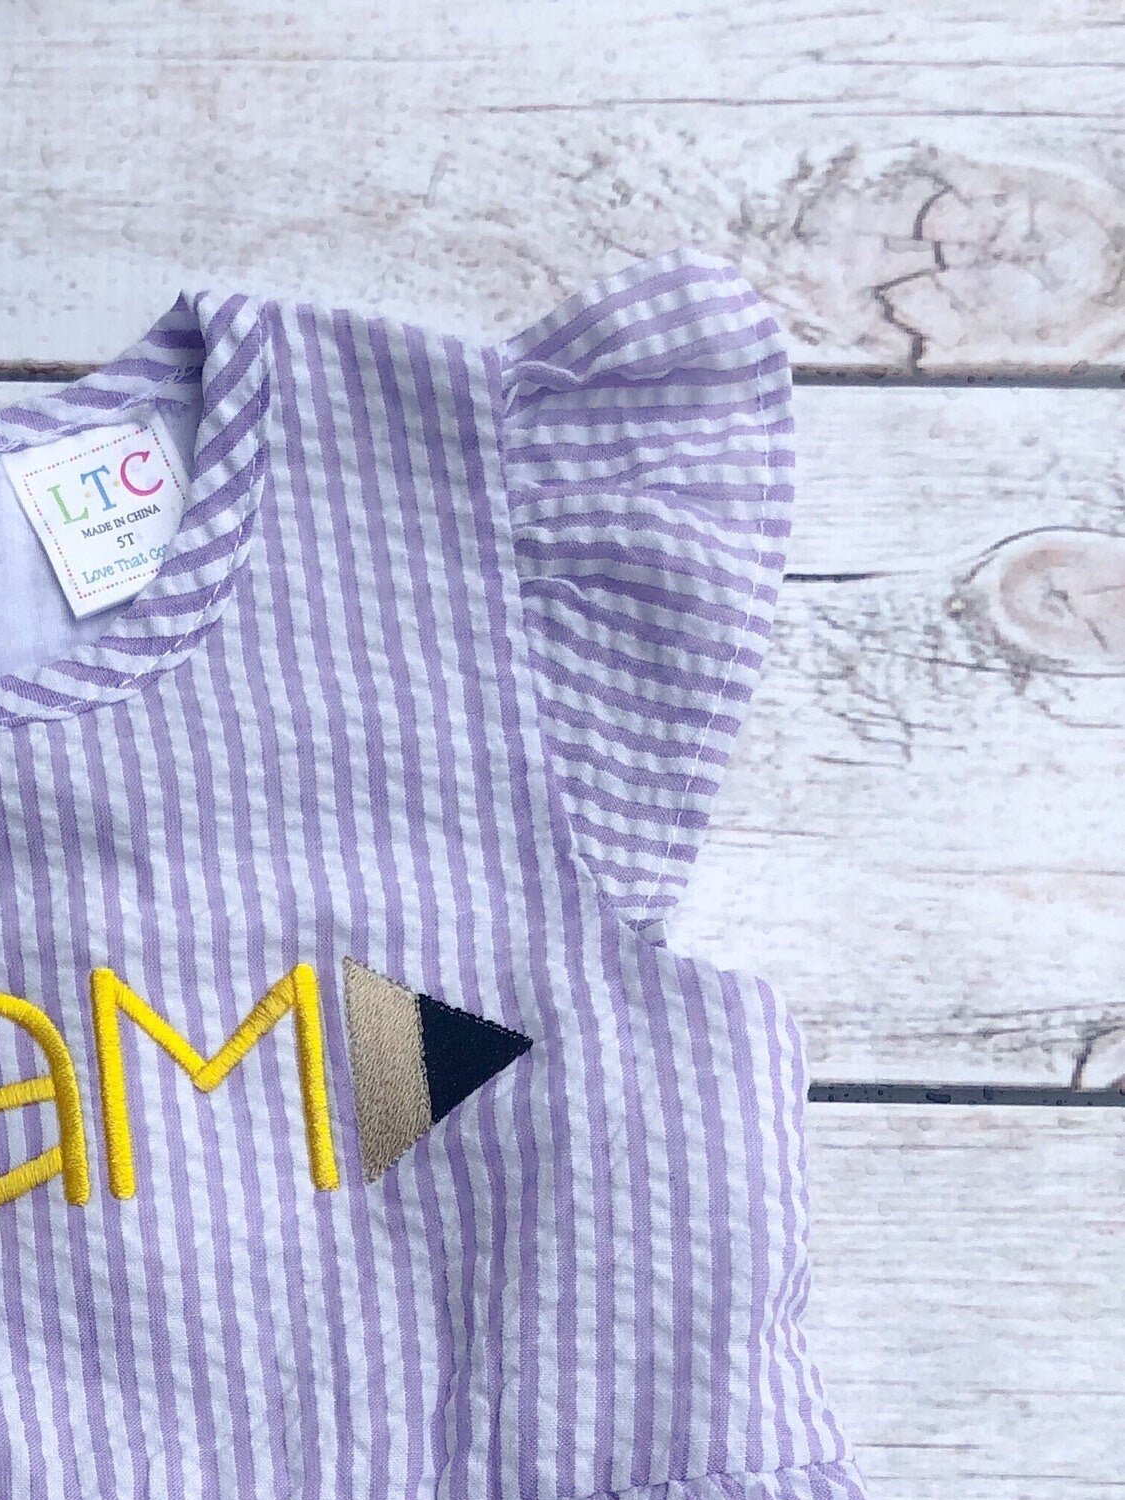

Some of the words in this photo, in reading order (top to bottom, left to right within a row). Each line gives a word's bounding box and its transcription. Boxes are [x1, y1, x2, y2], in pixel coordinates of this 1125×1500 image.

[81, 521, 113, 538] MADE
[113, 516, 126, 528] IN
[127, 504, 161, 523] CHINA
[116, 532, 135, 549] 5T
[81, 565, 115, 584] Love
[114, 552, 148, 572] That
